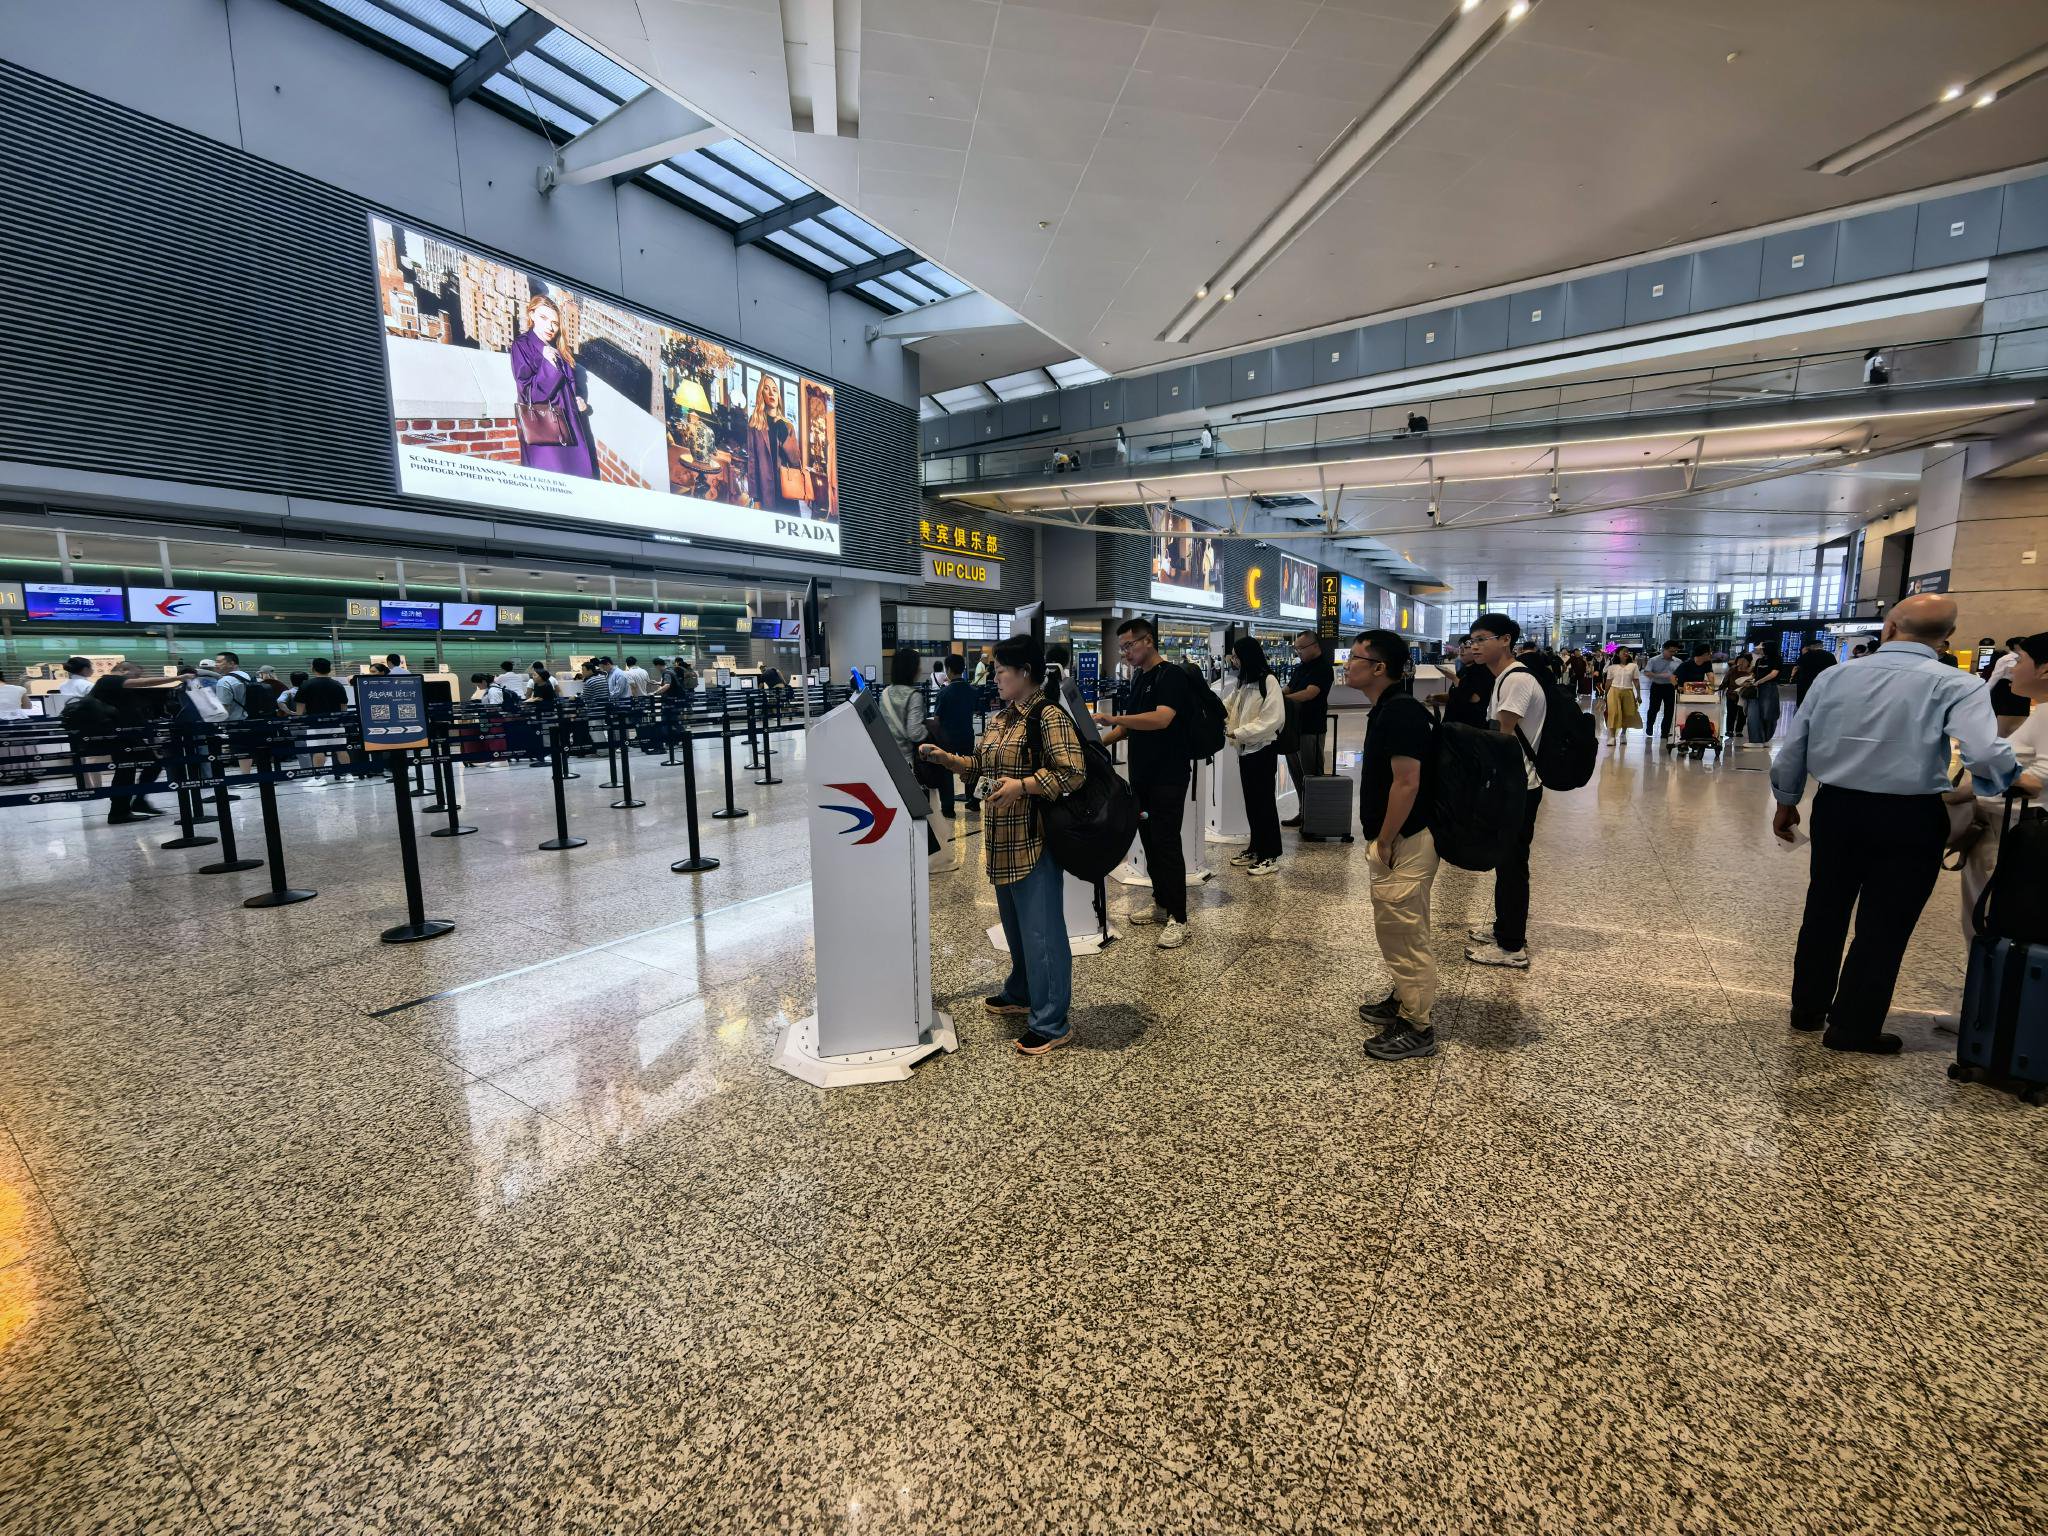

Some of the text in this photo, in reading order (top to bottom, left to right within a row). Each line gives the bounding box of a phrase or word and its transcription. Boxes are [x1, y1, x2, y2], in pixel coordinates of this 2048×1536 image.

[409, 455, 456, 467] SCARLETT
[410, 463, 483, 480] PHOTOGRAPHED
[774, 519, 835, 543] PRADA
[919, 520, 998, 554] 贵宾俱乐部
[933, 559, 987, 582] VIP CLUB
[58, 596, 95, 606] 经济舱
[221, 596, 256, 611] B12
[349, 601, 378, 617] B13
[500, 609, 520, 621] B14
